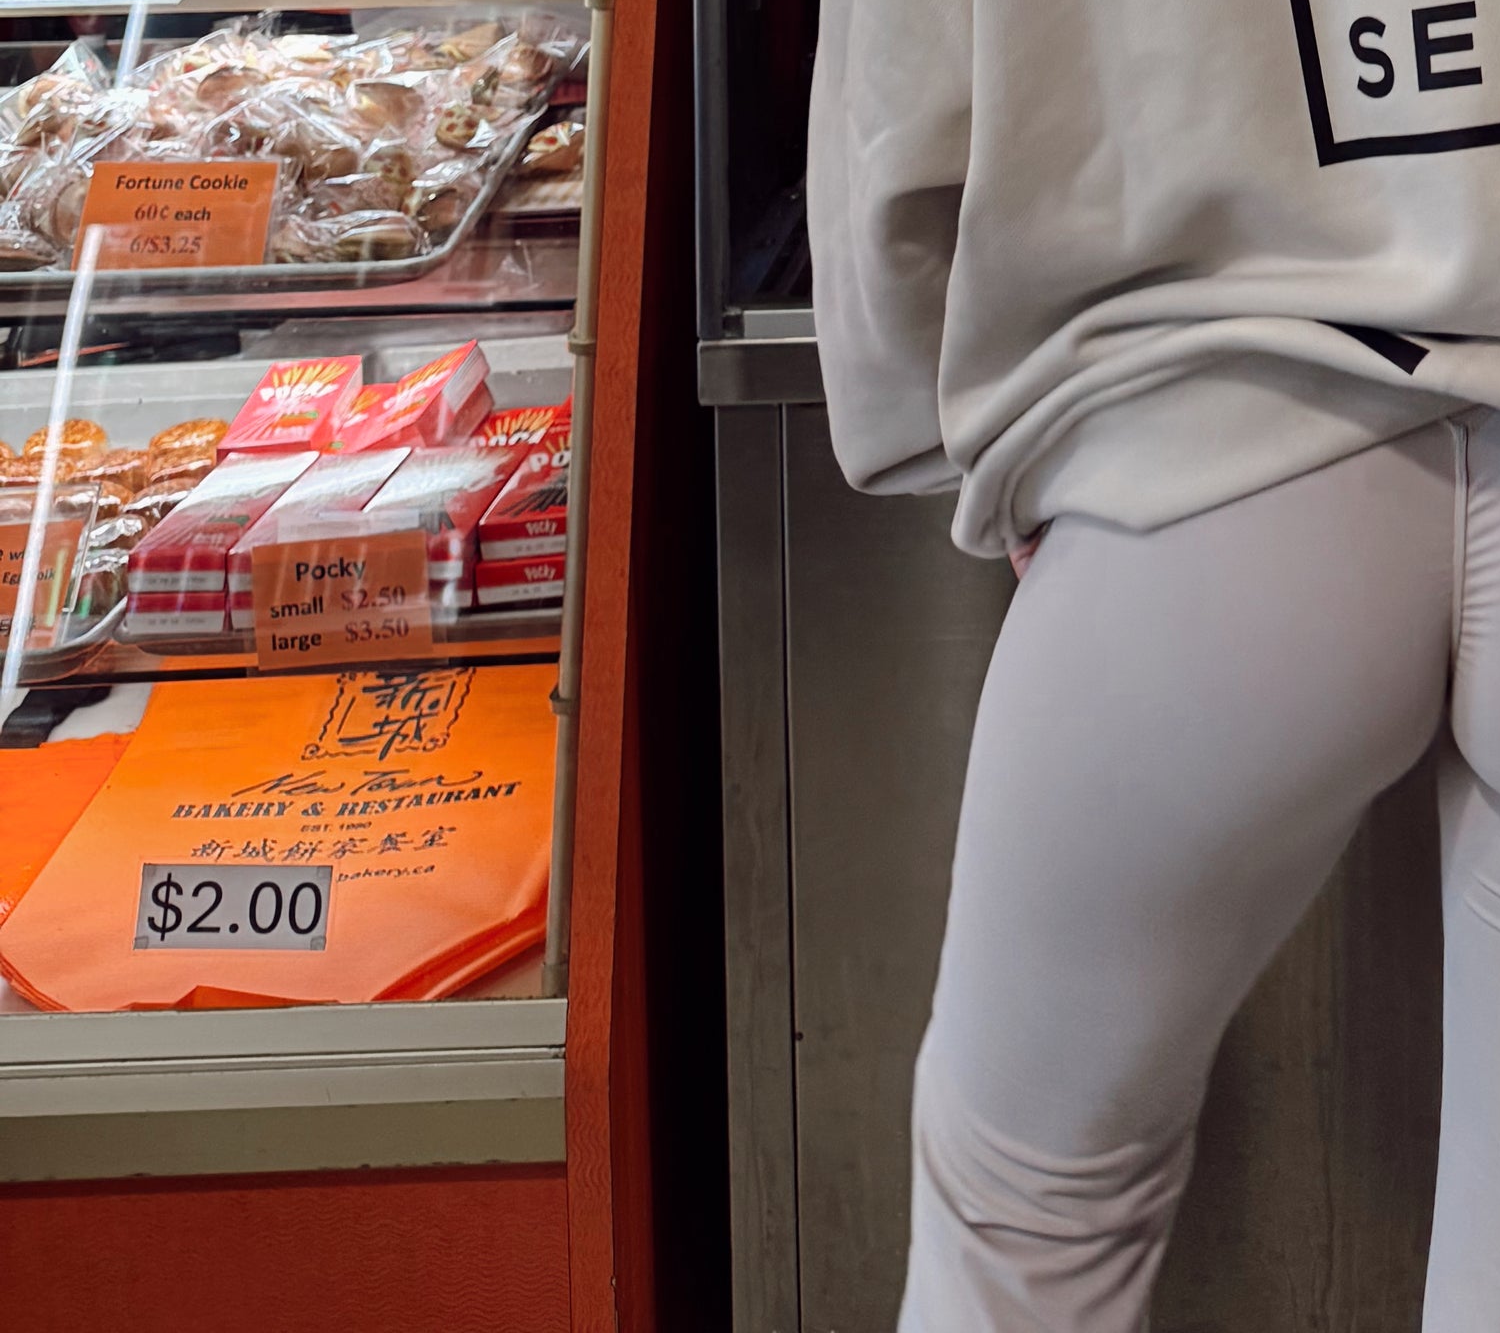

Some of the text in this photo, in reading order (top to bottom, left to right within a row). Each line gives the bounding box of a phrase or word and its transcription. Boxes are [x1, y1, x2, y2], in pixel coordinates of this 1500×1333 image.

[115, 173, 249, 191] Fortune Cookie
[174, 207, 211, 222] each
[294, 556, 366, 583] Pocky
[269, 586, 406, 620] small $2.50
[271, 617, 410, 654] large $3.50
[171, 780, 523, 819] BAKERY & RESTAURANT
[146, 872, 324, 943] $2.00
